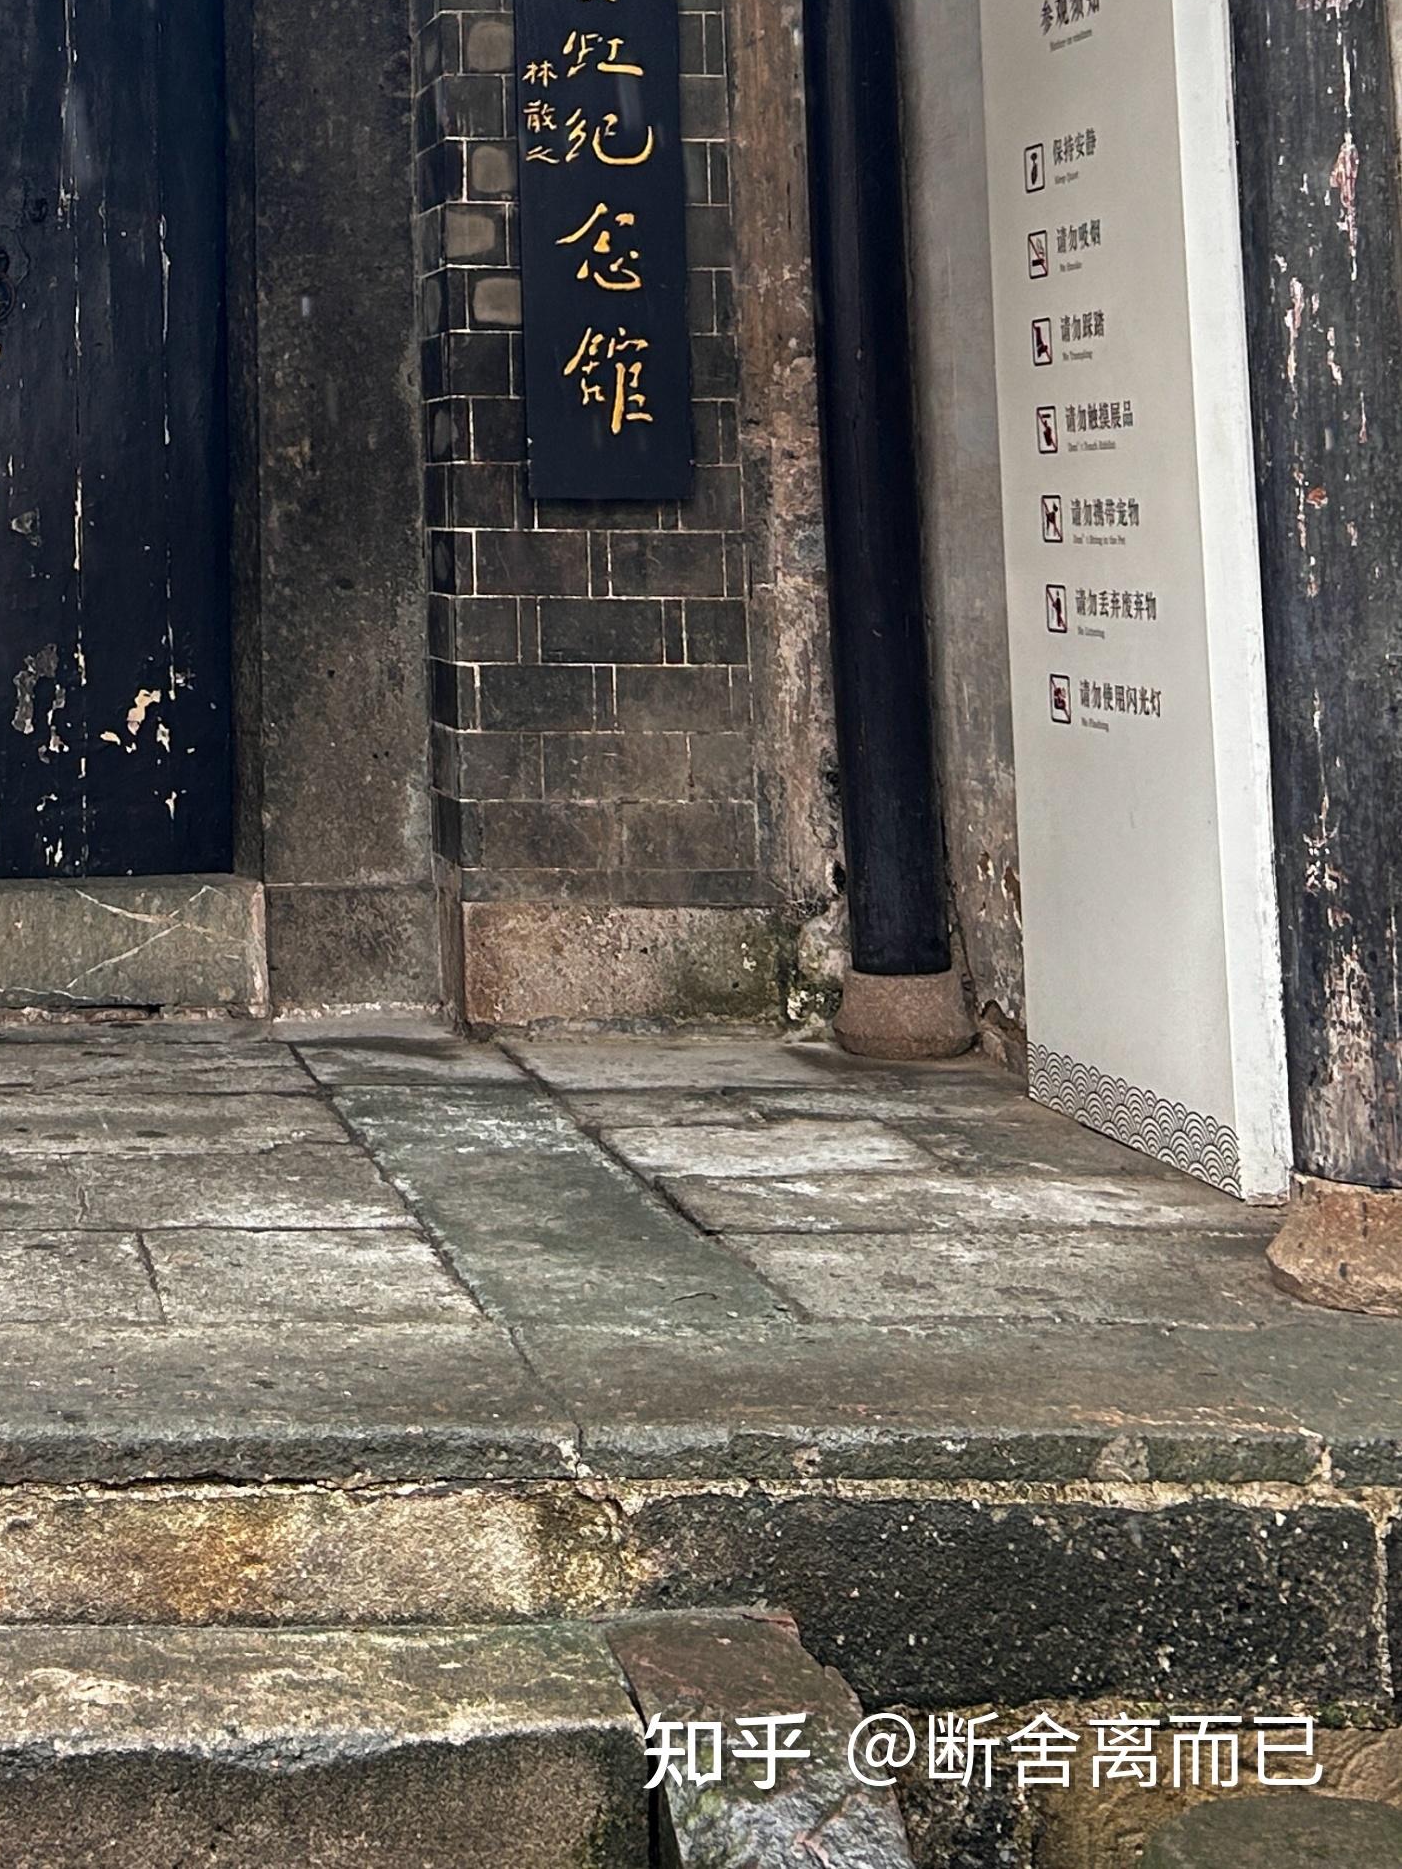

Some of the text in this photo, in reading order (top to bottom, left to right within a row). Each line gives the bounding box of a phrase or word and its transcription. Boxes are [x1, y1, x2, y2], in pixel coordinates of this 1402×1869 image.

[1053, 128, 1097, 166] 保持安静
[1056, 219, 1101, 254] 请勿吸烟
[1060, 310, 1105, 343] 请勿踩踏
[1065, 400, 1134, 433] 请勿触摸展品
[1070, 498, 1140, 528] 请勿携带宠物
[1075, 588, 1157, 621] 请勿丢弃废弃物
[1080, 679, 1162, 718] 请勿使用闪光灯
